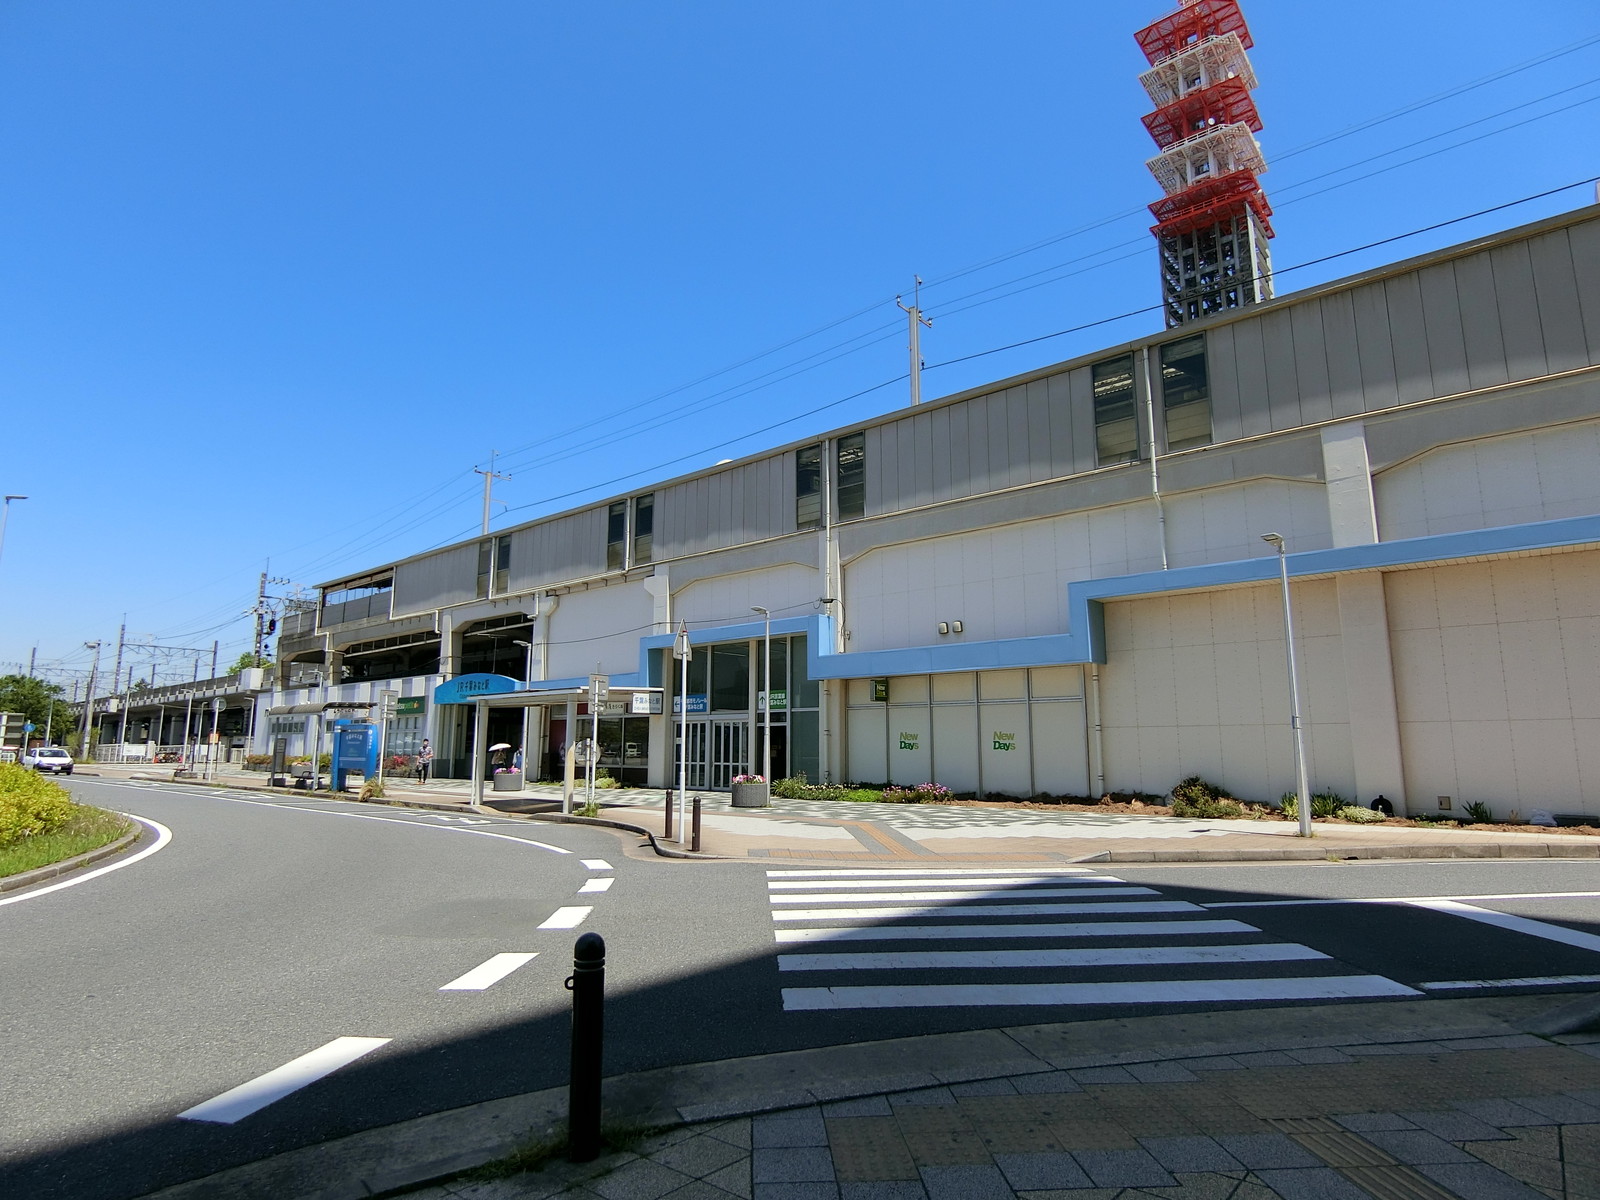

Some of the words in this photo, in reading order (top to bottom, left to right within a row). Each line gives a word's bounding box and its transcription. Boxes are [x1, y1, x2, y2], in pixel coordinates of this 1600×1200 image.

[900, 732, 918, 741] New
[993, 731, 1015, 741] New
[899, 741, 919, 750] Days
[993, 741, 1016, 751] Days
